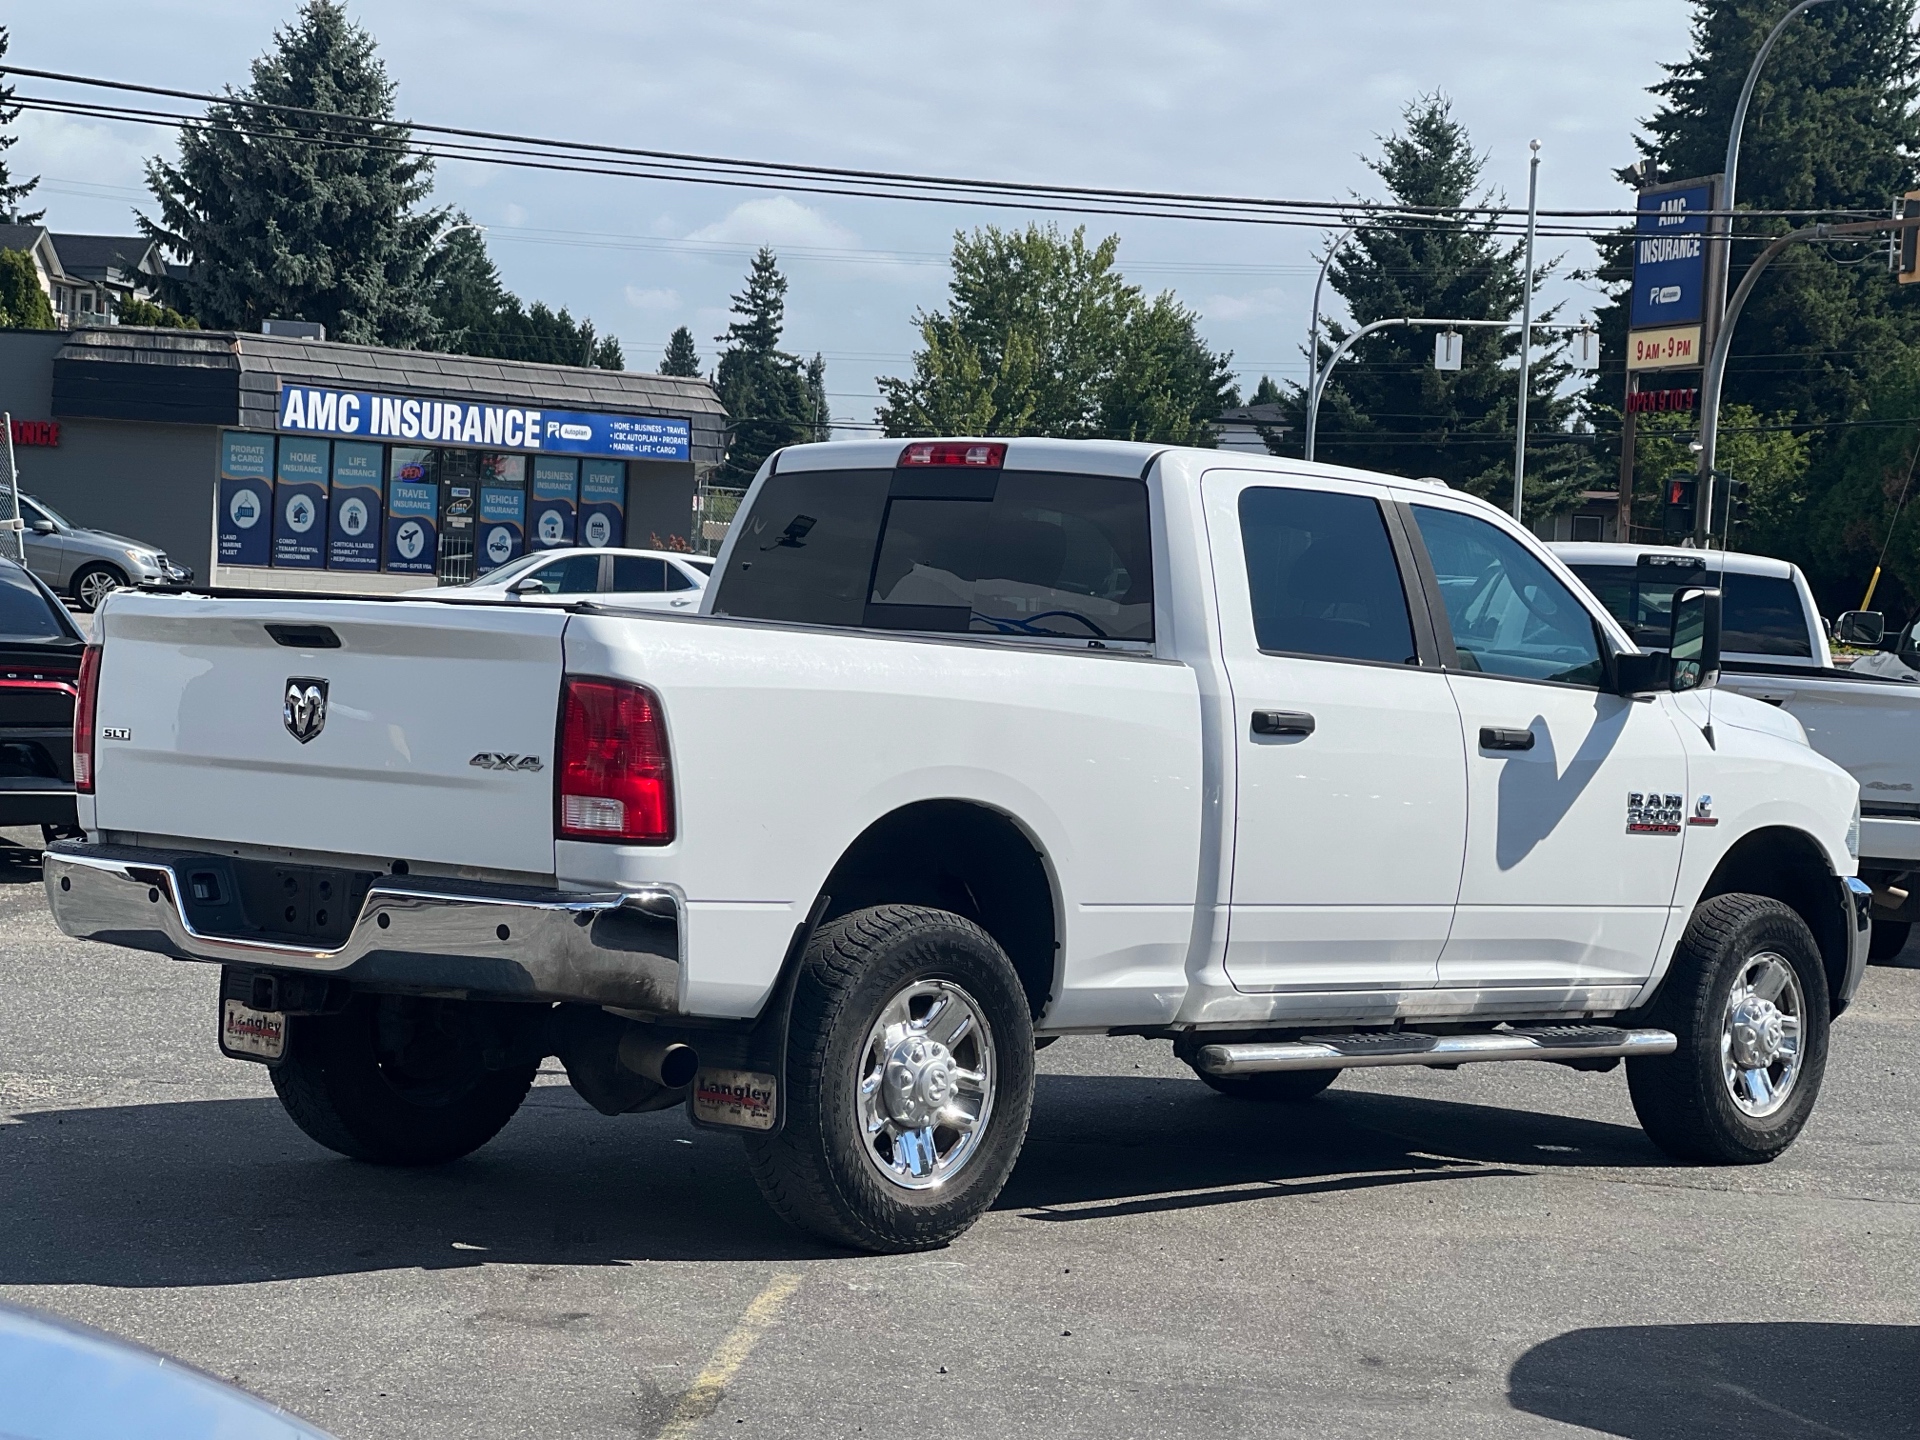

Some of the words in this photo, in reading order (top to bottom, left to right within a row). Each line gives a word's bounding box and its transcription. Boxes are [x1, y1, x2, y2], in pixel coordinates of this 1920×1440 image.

[1658, 197, 1687, 227] AMC
[1639, 233, 1701, 265] INSURANCE
[1637, 340, 1644, 361] 9
[1645, 343, 1660, 360] AM
[1668, 336, 1675, 358] 9
[1676, 339, 1691, 357] PM
[1627, 391, 1656, 413] OPEN
[1659, 389, 1666, 411] 9
[1669, 389, 1683, 410] TO
[1686, 388, 1693, 410] 9
[282, 389, 360, 433] AMC
[370, 397, 541, 448] INSURANCE
[0, 419, 60, 447] ANCE
[564, 428, 588, 437] Autoplan
[613, 422, 630, 431] HOME
[634, 423, 662, 432] BUSINESS
[667, 426, 687, 435] TRAVEL
[613, 433, 627, 441] ICBC
[627, 434, 658, 443] AUTOPLAN
[662, 437, 688, 445] PRORATE
[230, 444, 265, 454] PRORATE
[612, 443, 634, 451] MARINE
[639, 445, 651, 453] LIFE
[237, 454, 264, 463] CARGO
[289, 452, 317, 463] HOME
[348, 456, 367, 467] LIFE
[229, 464, 264, 473] INSURANCE
[282, 464, 323, 474] INSURANCE
[337, 468, 377, 477] INSURANCE
[536, 470, 574, 481] BUSINESS
[589, 474, 615, 484] EVENT
[536, 482, 572, 491] INSURANCE
[584, 485, 619, 494] INSURANCE
[396, 488, 429, 499] TRAVEL
[485, 494, 519, 505] VEHICLE
[393, 501, 431, 510] INSURANCE
[484, 505, 519, 515] INSURANCE
[103, 728, 129, 739] SLT
[1627, 791, 1683, 809] RAM
[698, 1078, 771, 1105] Langley
